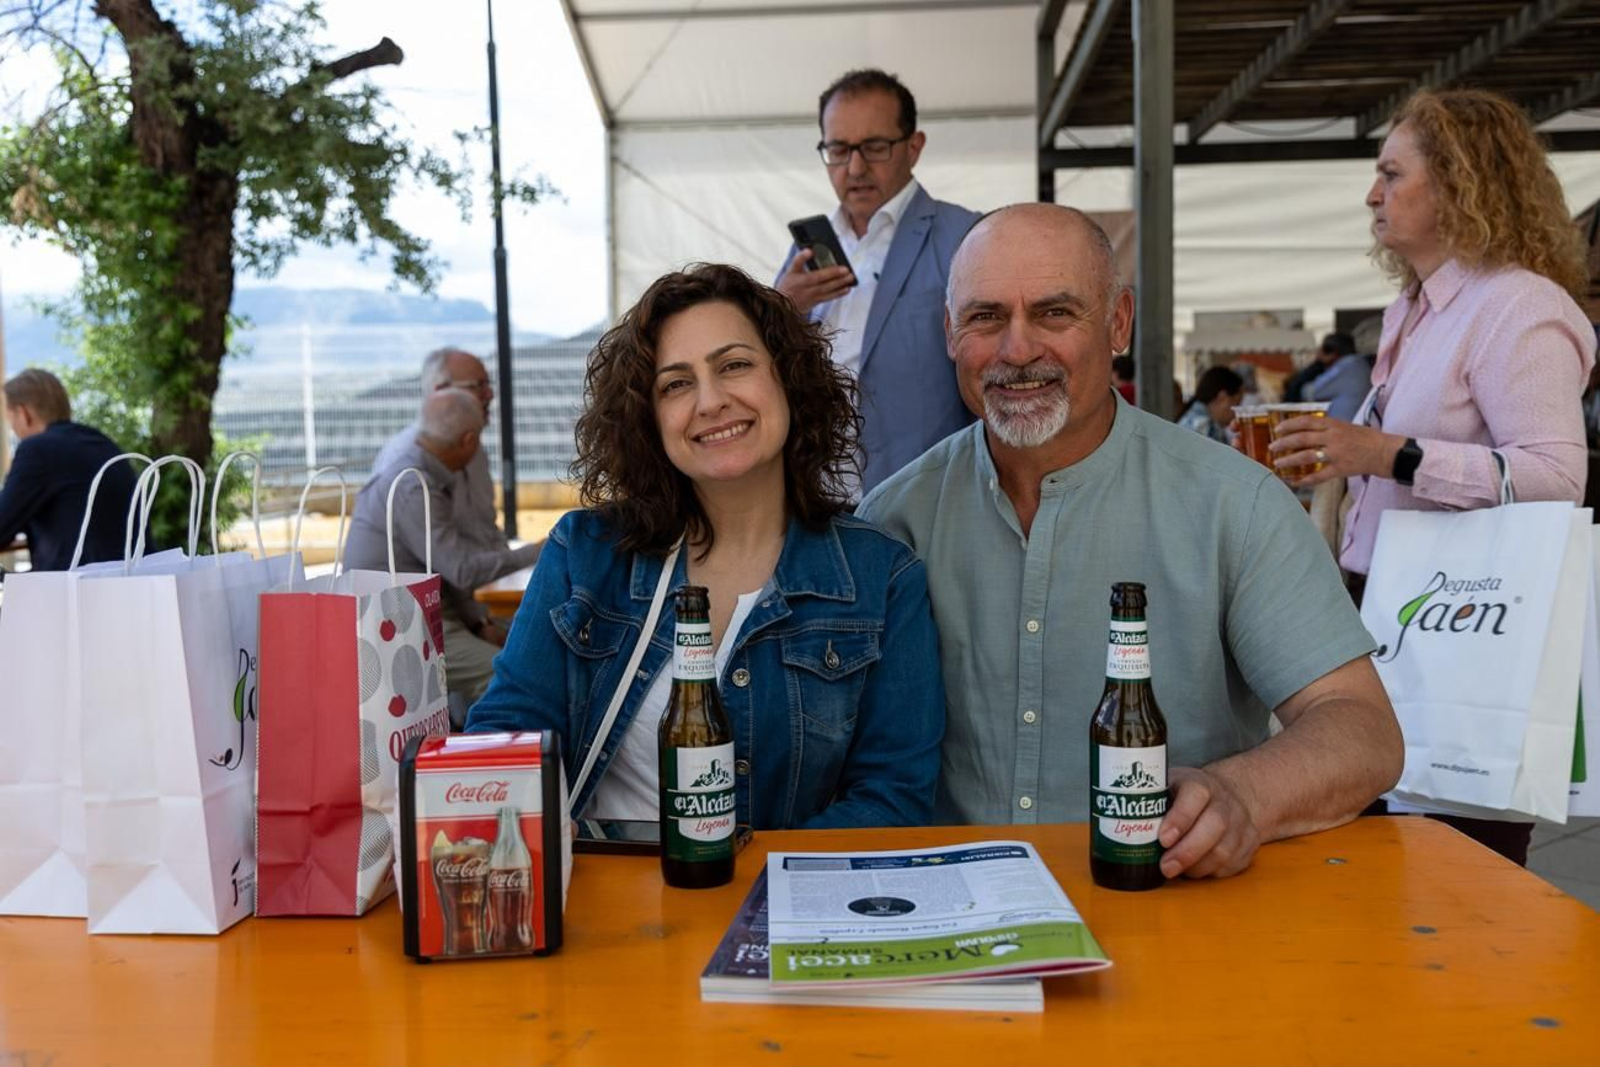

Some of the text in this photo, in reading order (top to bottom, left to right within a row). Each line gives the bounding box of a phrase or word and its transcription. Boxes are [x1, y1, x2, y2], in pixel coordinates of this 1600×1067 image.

[1421, 571, 1502, 597] Degusta
[445, 781, 511, 804] Coca-Cola
[435, 856, 490, 877] Coca-Cola
[787, 944, 984, 971] Mercacei
